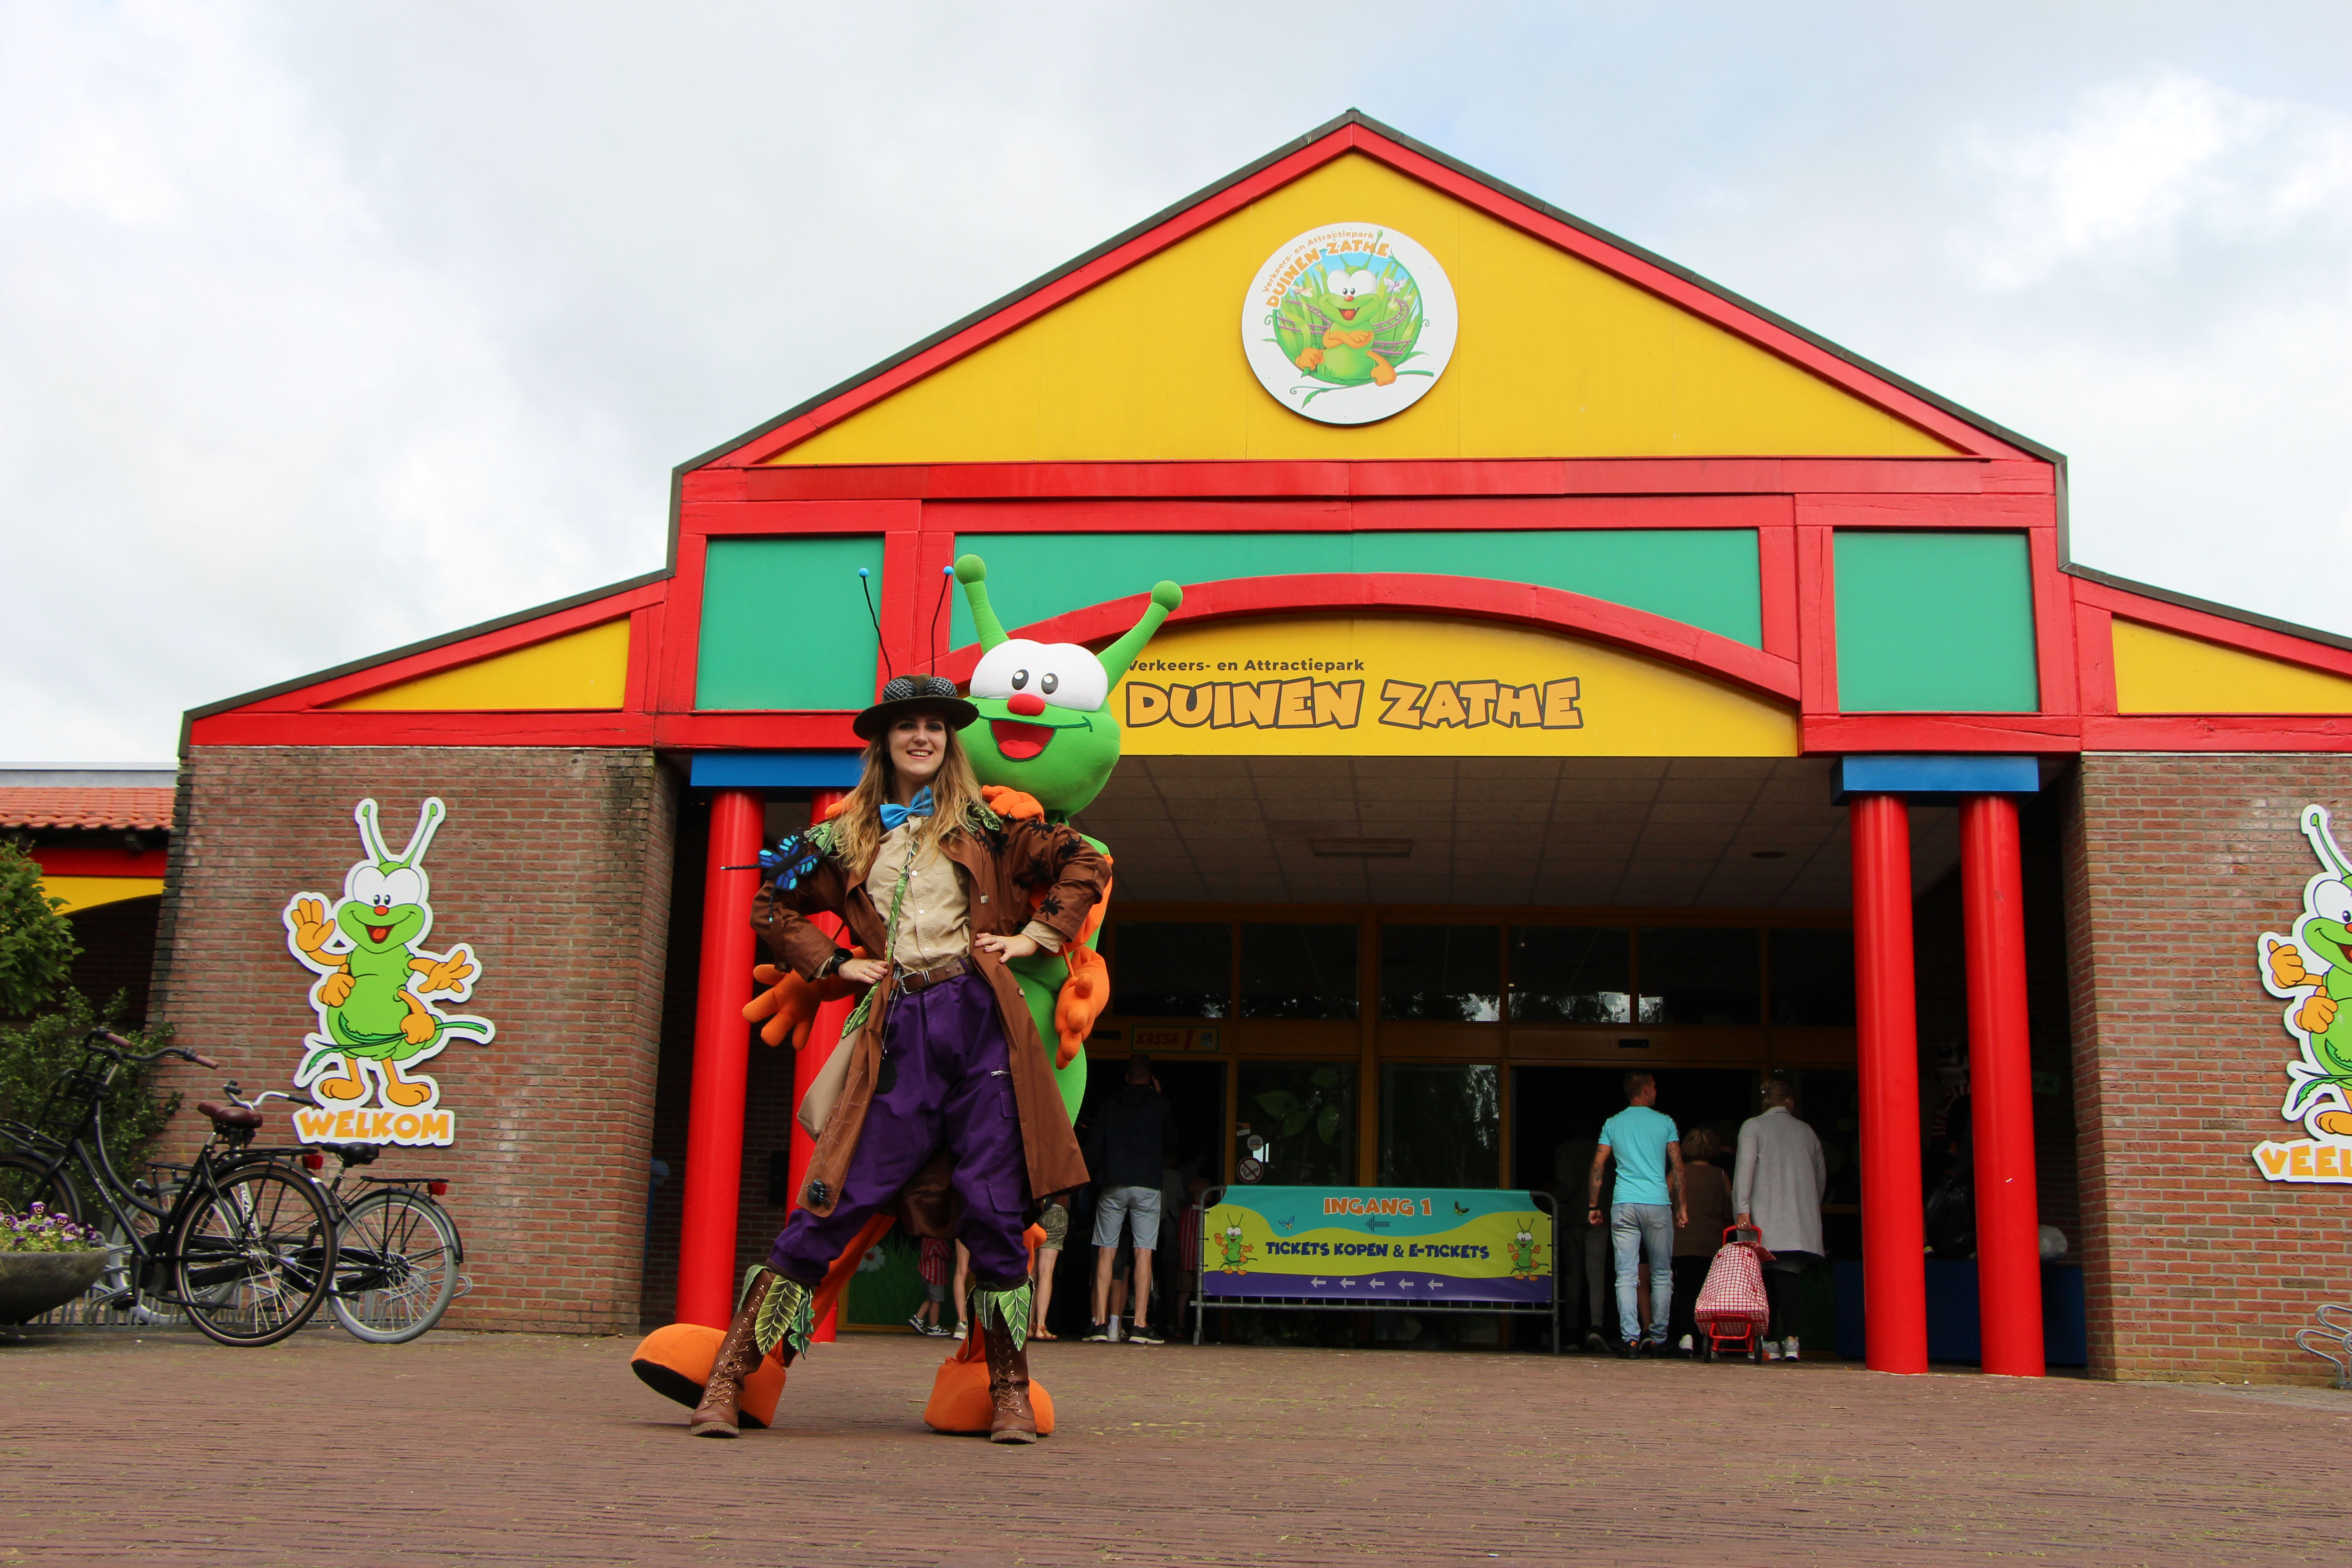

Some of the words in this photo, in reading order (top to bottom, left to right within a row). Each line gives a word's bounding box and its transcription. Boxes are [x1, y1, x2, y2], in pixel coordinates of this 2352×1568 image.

[1262, 254, 1293, 292] Verkeers-
[1294, 244, 1306, 254] en
[1307, 230, 1374, 246] Attractiepark
[1265, 247, 1321, 309] DUINEN
[1326, 239, 1390, 257] ZATHE
[1129, 660, 1210, 671] Verkeers-
[1217, 662, 1238, 671] en
[1244, 658, 1365, 673] Attractiepark
[1126, 676, 1365, 730] DUINEN
[1378, 676, 1583, 730] ZATHE
[1136, 1032, 1178, 1045] KASSA
[1183, 1029, 1194, 1050] 1
[298, 1109, 450, 1139] WELKOM
[1323, 1197, 1415, 1217] INGANG
[1420, 1197, 1432, 1216] 1
[1265, 1241, 1330, 1256] TICKETS
[1334, 1242, 1388, 1257] KOPEN
[1392, 1244, 1404, 1258] &
[1409, 1243, 1490, 1259] E-TICKETS
